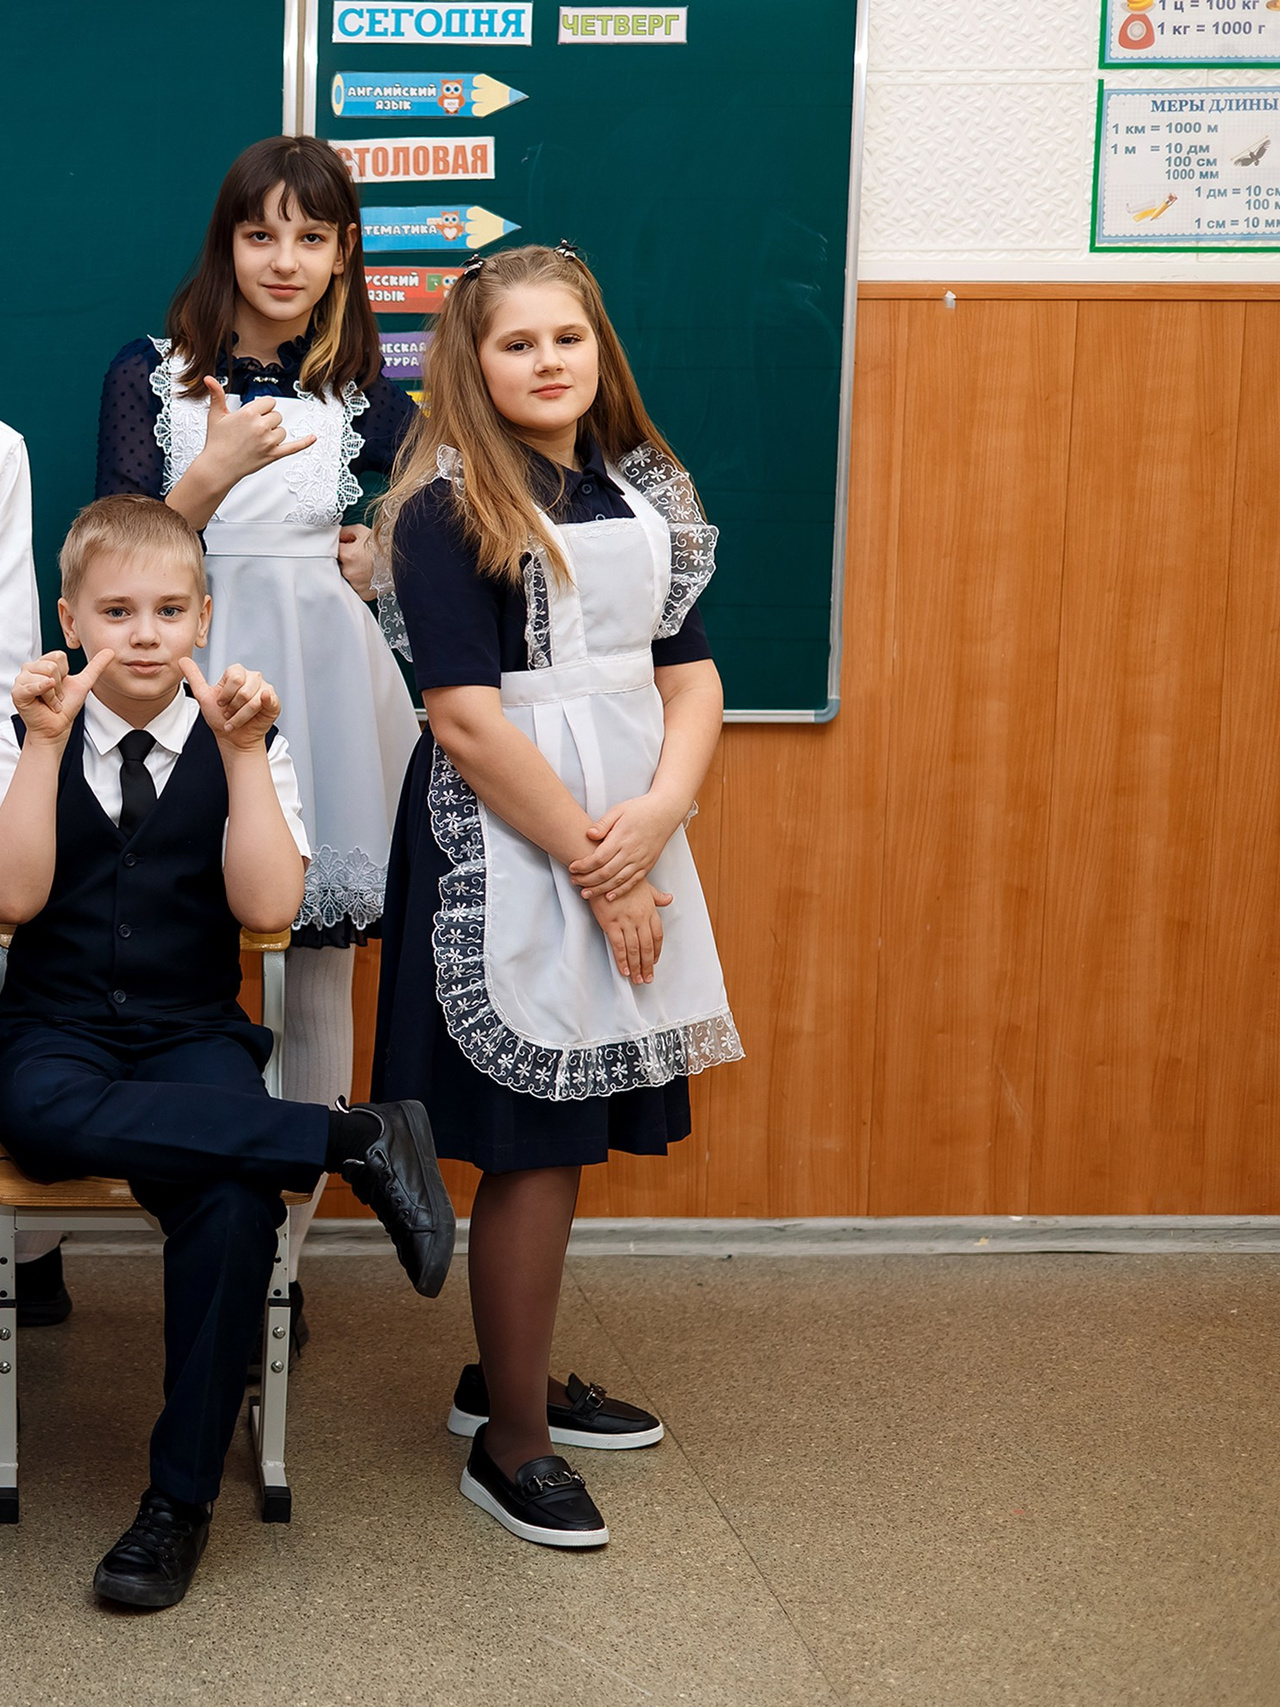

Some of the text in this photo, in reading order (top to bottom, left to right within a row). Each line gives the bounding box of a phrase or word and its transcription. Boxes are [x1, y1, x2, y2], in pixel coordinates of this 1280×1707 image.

[1159, 0, 1166, 10] 1
[1174, 1, 1184, 12] ц
[1207, 0, 1236, 10] 100
[1242, 0, 1259, 10] кг
[337, 7, 527, 38] СЕГОДНЯ
[561, 14, 680, 36] ЧЕТВЕРГ
[1157, 22, 1165, 35] 1
[1173, 25, 1190, 35] кг
[1212, 21, 1252, 35] 1000
[1258, 25, 1266, 34] г
[347, 84, 437, 97] АНГЛИЙСКИЙ
[375, 100, 412, 110] ЯЗЫК
[1151, 98, 1279, 113] МЕРЫ ДЛИНЫ
[1112, 123, 1119, 134] 1
[1125, 125, 1146, 134] км
[1166, 122, 1202, 133] 1000
[1207, 124, 1218, 133] м
[1111, 144, 1118, 154] 1
[1124, 145, 1136, 154] м
[1165, 143, 1183, 154] 10
[1187, 145, 1210, 155] дм
[1165, 156, 1217, 167] 100 см
[1165, 169, 1219, 180] 1000 мм
[1195, 186, 1201, 197] 1
[1206, 188, 1227, 199] дм
[1245, 185, 1262, 197] 10
[1245, 198, 1270, 210] 100
[1194, 218, 1201, 228] 1
[1207, 220, 1226, 229] см
[1243, 216, 1260, 228] 10
[361, 225, 437, 235] ТЕМАТИКА
[365, 272, 419, 286] УССКИЙ
